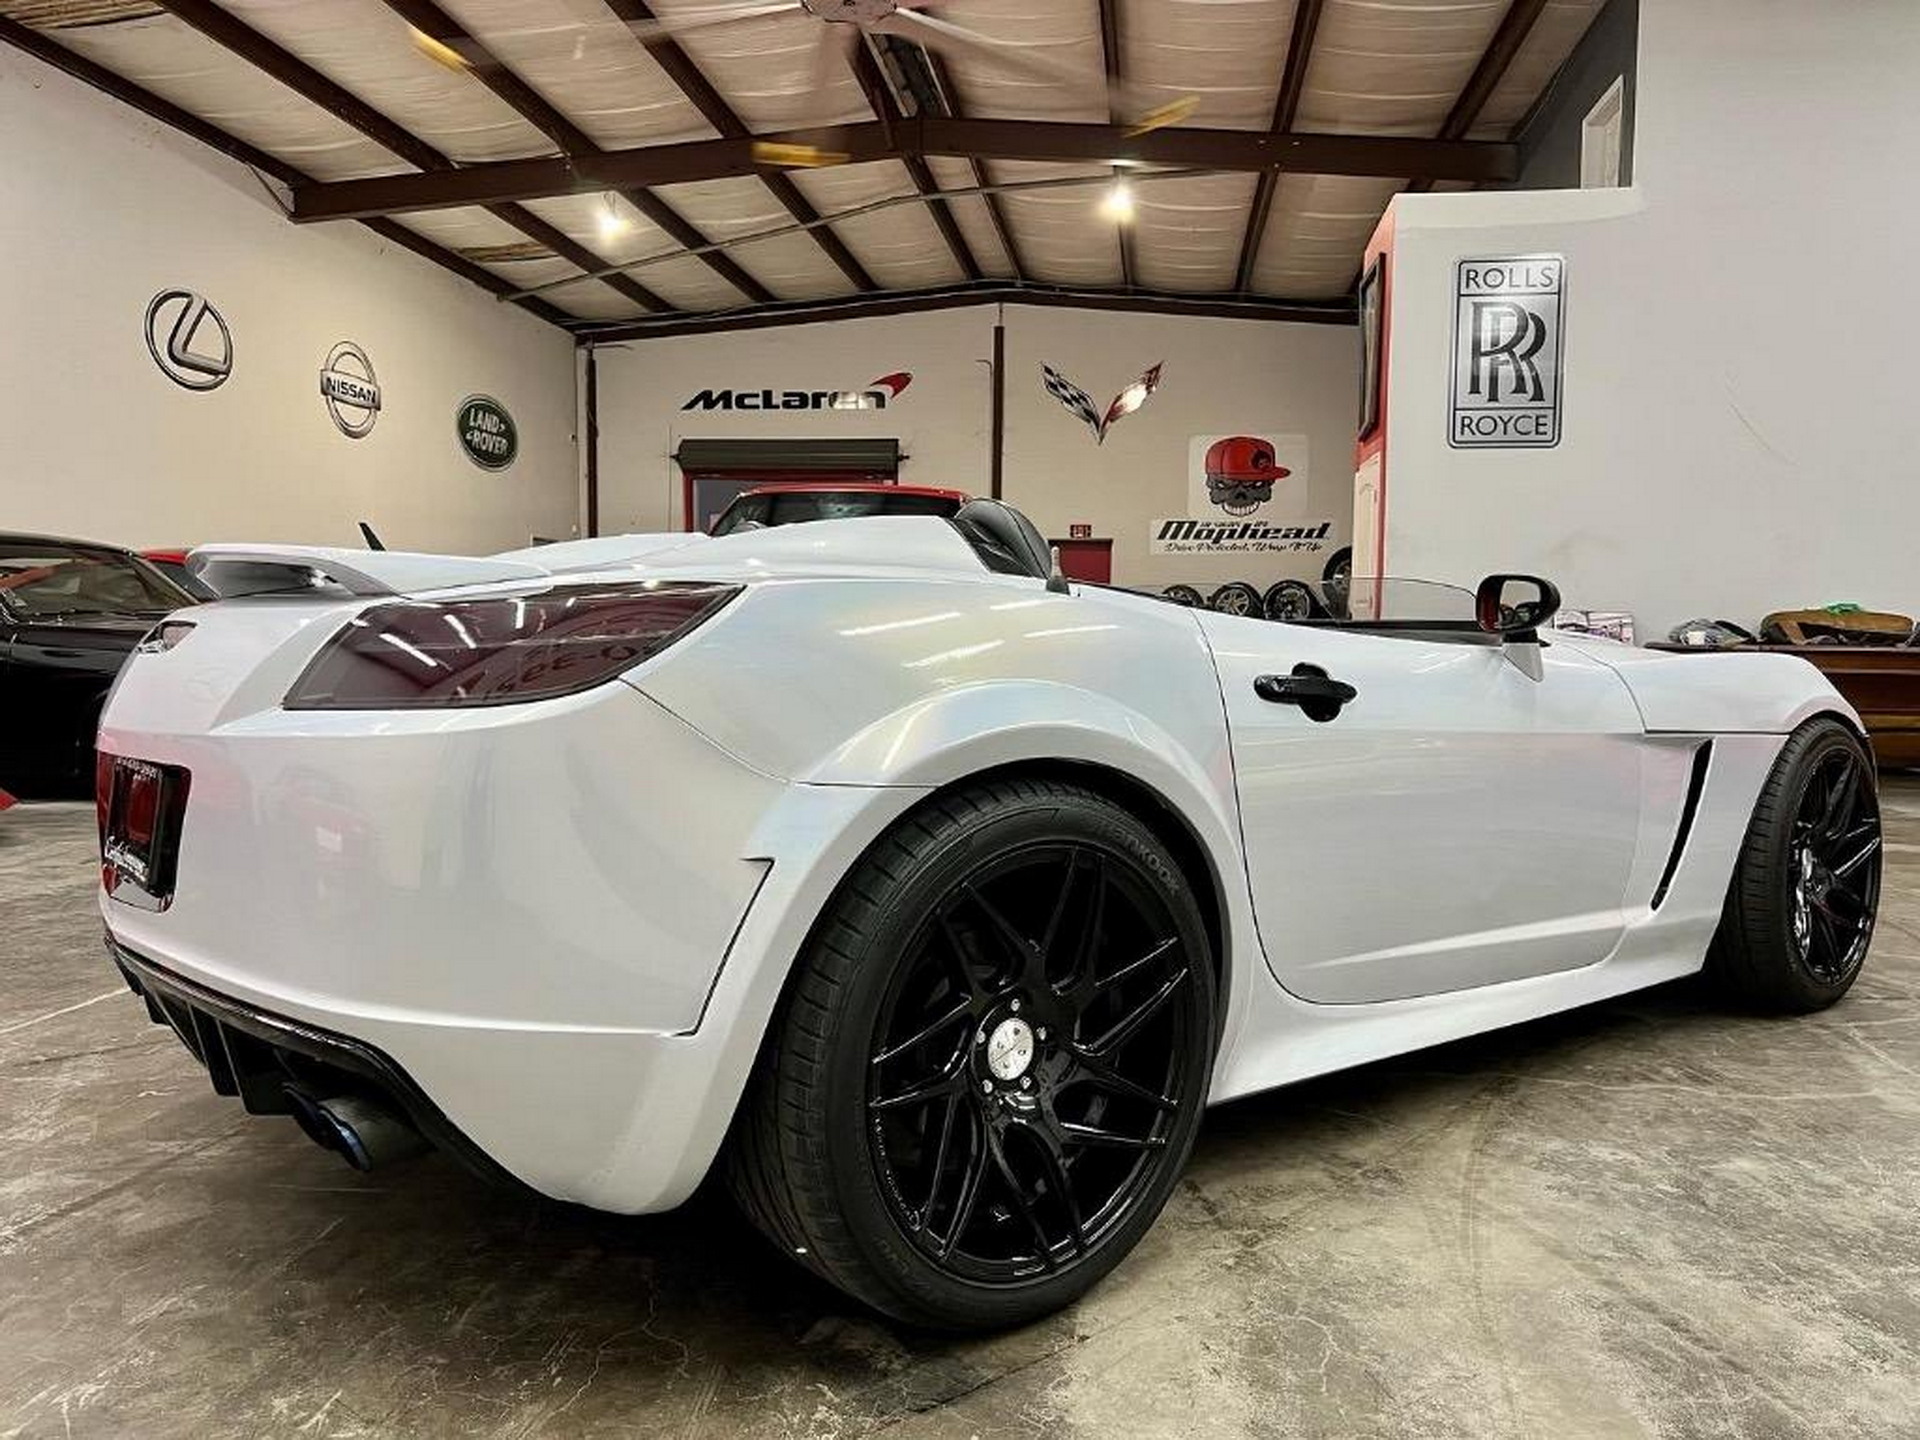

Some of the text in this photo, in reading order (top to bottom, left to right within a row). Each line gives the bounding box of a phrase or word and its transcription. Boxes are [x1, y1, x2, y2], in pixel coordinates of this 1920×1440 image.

[1465, 267, 1554, 289] ROLLS
[325, 376, 376, 404] NISSAN
[681, 389, 887, 410] McLaren
[469, 407, 500, 433] LAND
[1460, 414, 1548, 437] ROYCE
[472, 429, 509, 455] ROVER
[1157, 520, 1331, 545] Mophead
